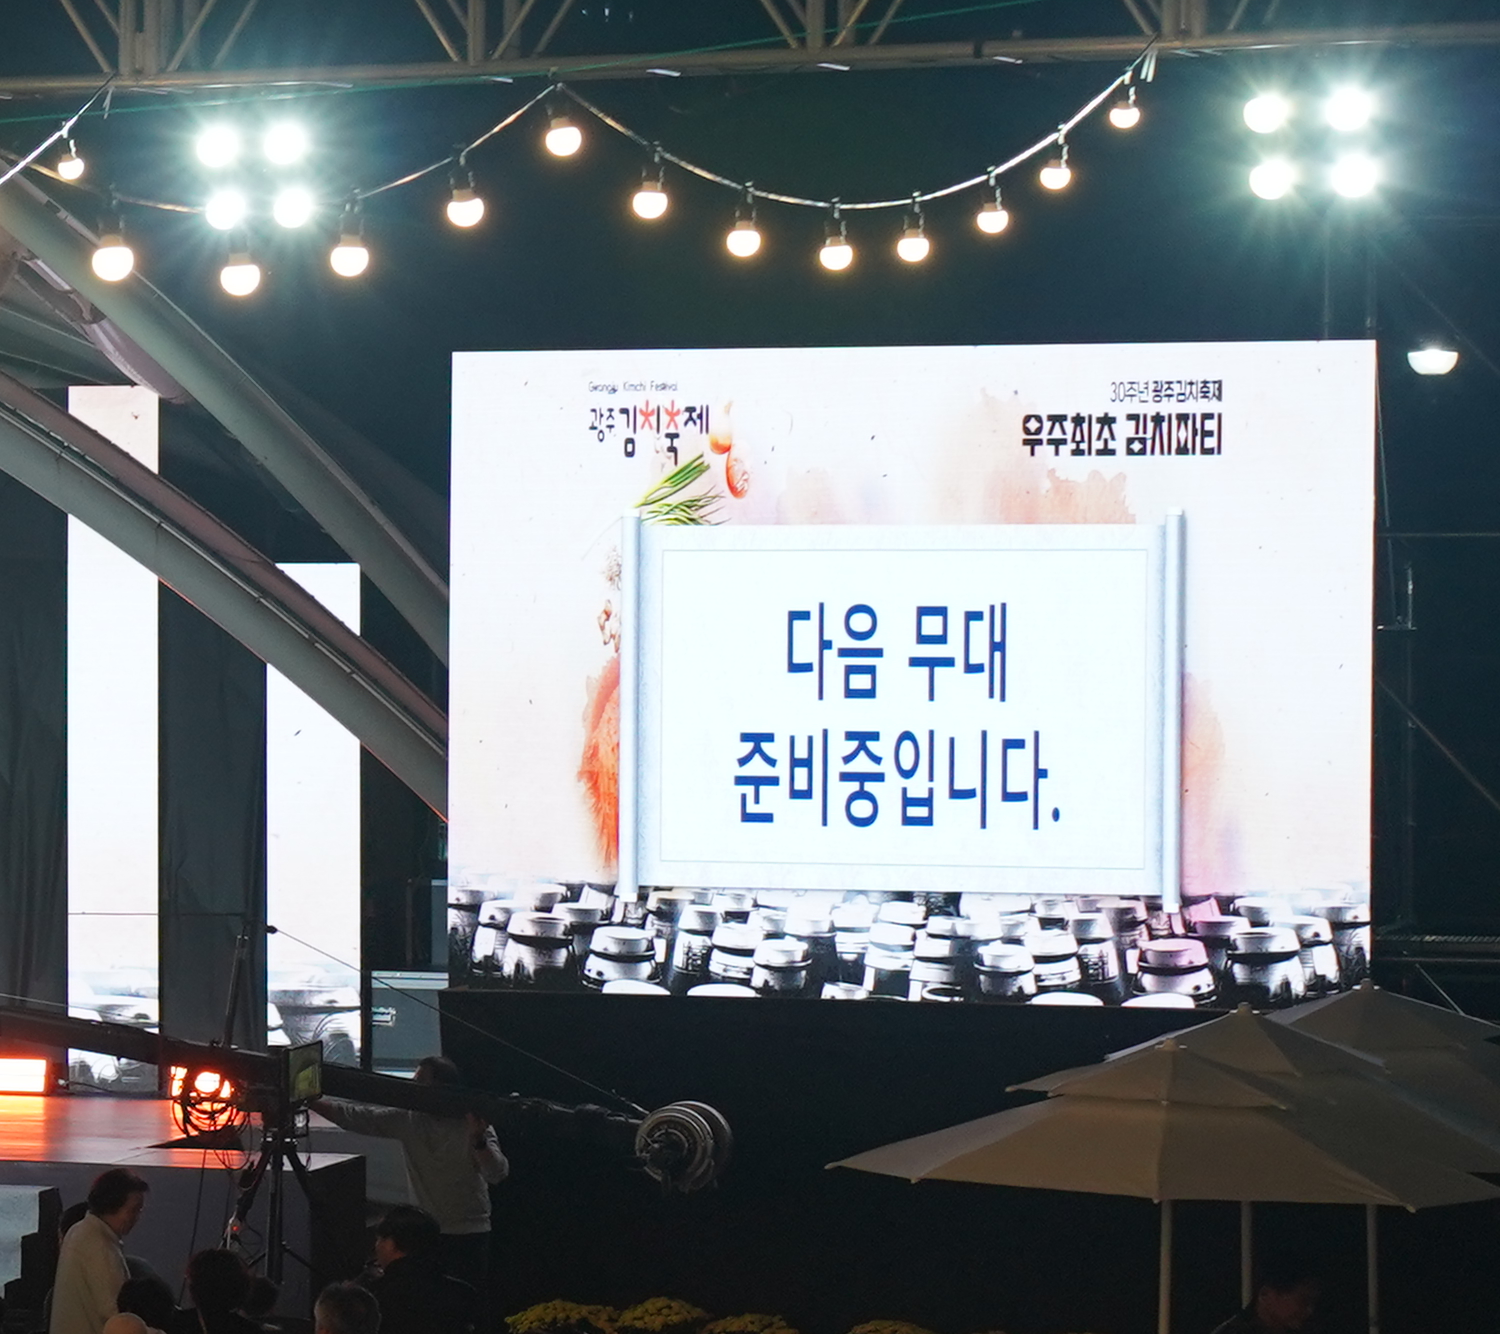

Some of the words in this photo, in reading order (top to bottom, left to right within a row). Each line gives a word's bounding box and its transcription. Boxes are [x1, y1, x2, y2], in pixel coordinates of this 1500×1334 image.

[1110, 381, 1149, 403] 30주년
[1152, 379, 1222, 403] 광주김치축제
[1022, 412, 1117, 456] 우주최초
[1125, 412, 1222, 456] 김치파티
[785, 602, 884, 703] 다음
[907, 602, 1009, 703] 무대
[732, 727, 1062, 831] 준비중입니다.
